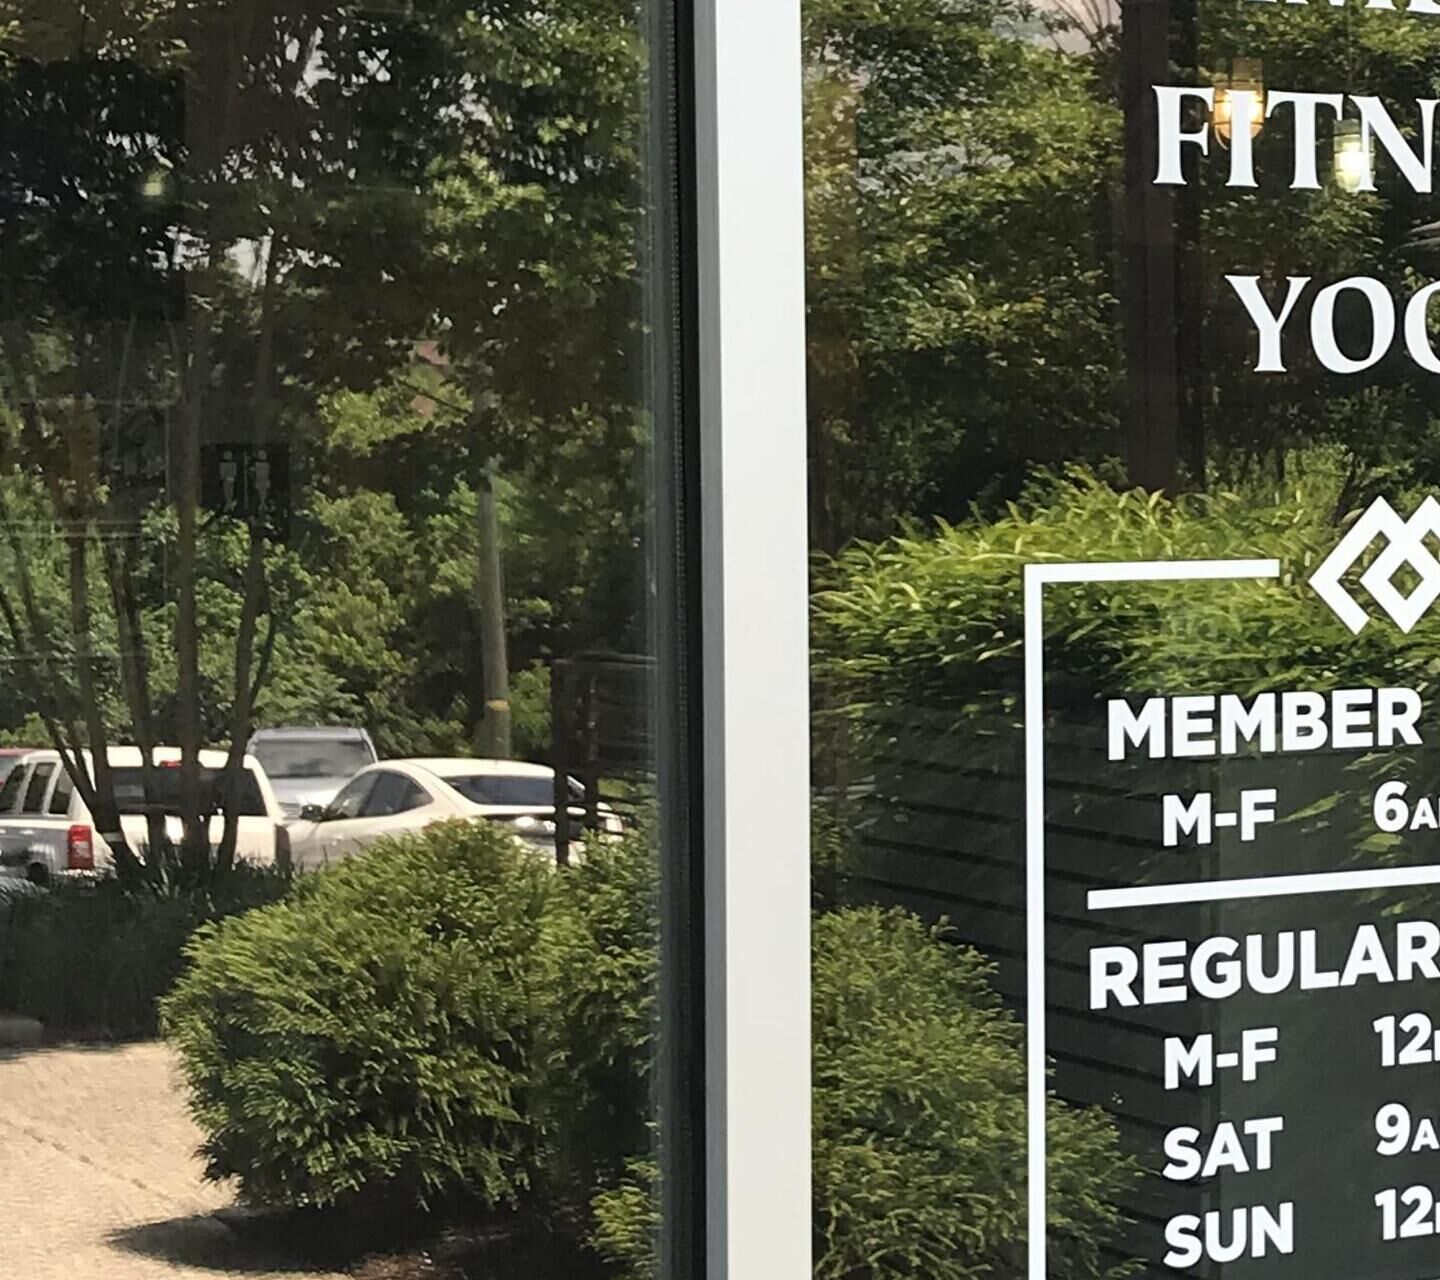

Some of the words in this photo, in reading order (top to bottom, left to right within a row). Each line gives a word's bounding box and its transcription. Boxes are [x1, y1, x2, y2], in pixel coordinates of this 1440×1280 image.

[1108, 687, 1423, 761] MEMBER
[1163, 788, 1277, 846] M-F
[1165, 1027, 1278, 1090] M-F
[1162, 1116, 1283, 1180] SAT
[1163, 1202, 1293, 1268] SUN
